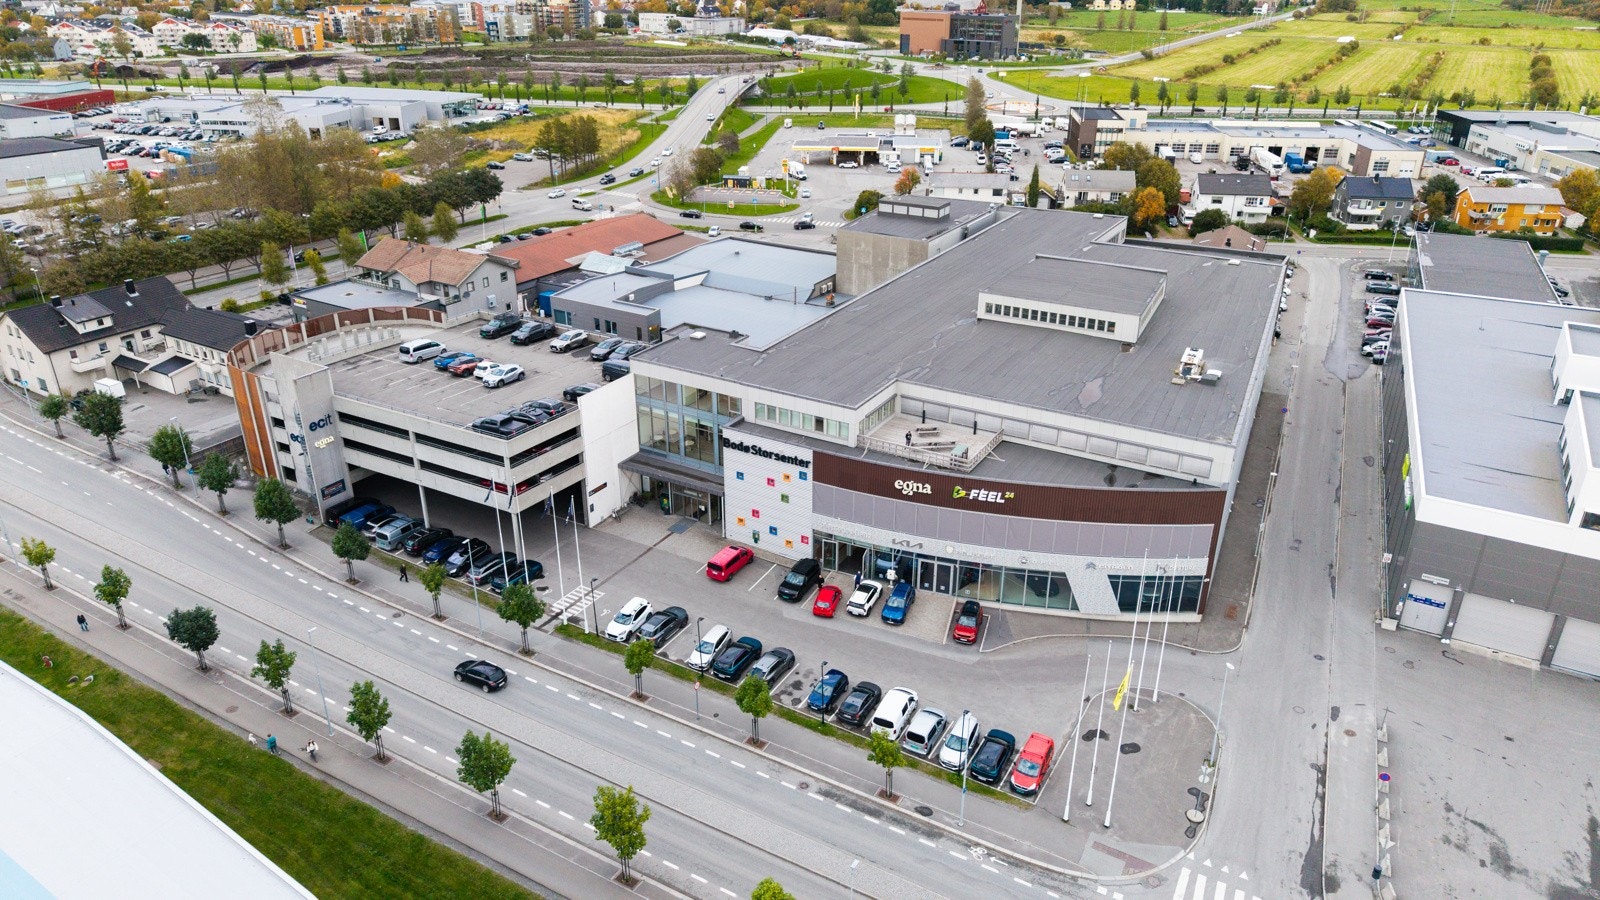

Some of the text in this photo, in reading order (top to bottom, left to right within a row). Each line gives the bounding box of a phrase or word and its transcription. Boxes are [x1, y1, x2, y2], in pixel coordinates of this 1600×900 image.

[309, 414, 333, 432] ecit
[723, 437, 811, 469] Bodø Storsenter
[894, 479, 932, 496] egna
[1004, 491, 1015, 499] 24
